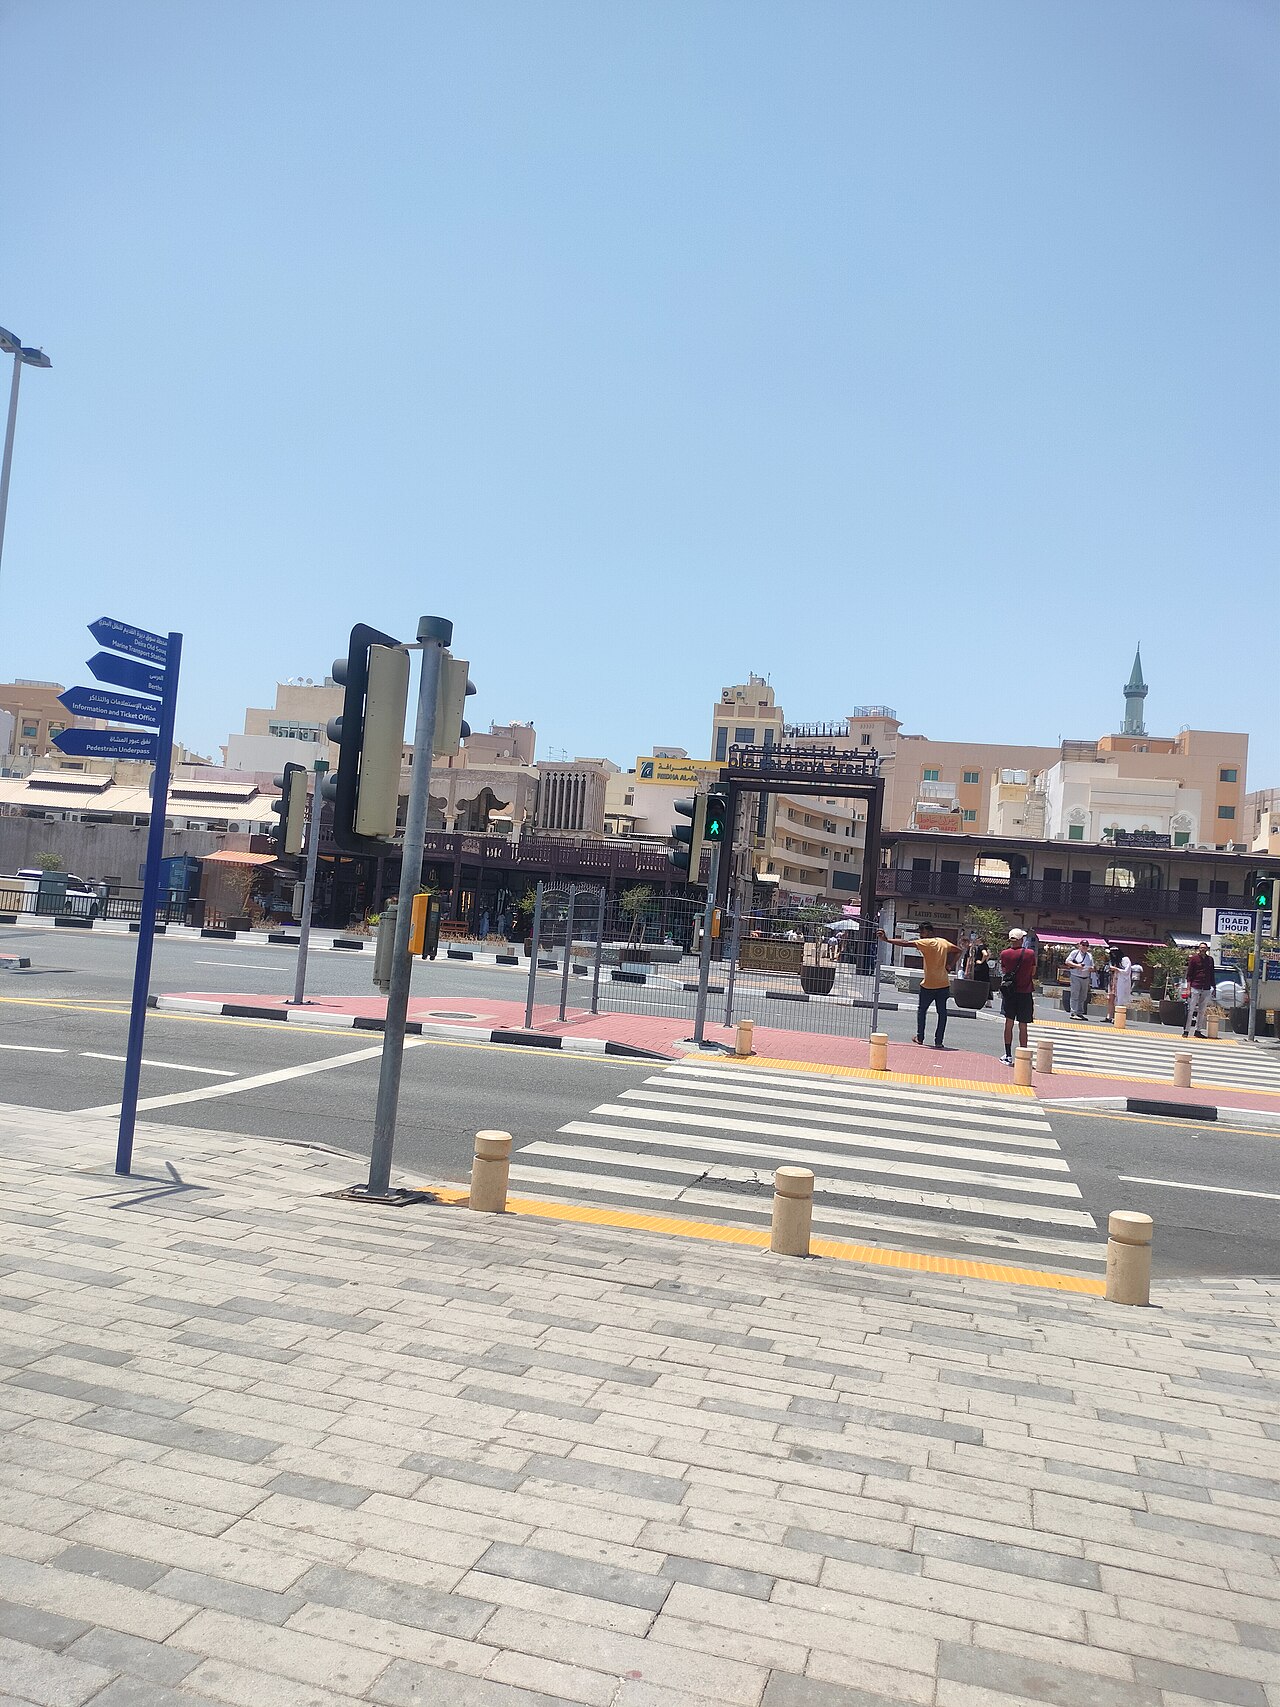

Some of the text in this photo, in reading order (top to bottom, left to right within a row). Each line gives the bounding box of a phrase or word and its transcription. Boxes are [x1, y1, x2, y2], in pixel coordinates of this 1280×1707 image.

[112, 640, 166, 662] Marine Transport Station
[134, 639, 146, 647] Deira
[156, 646, 166, 655] Souq
[148, 682, 162, 691] Berths
[73, 703, 107, 714] Information
[120, 711, 137, 719] Ticket
[138, 713, 156, 722] Office
[831, 764, 878, 777] STREET
